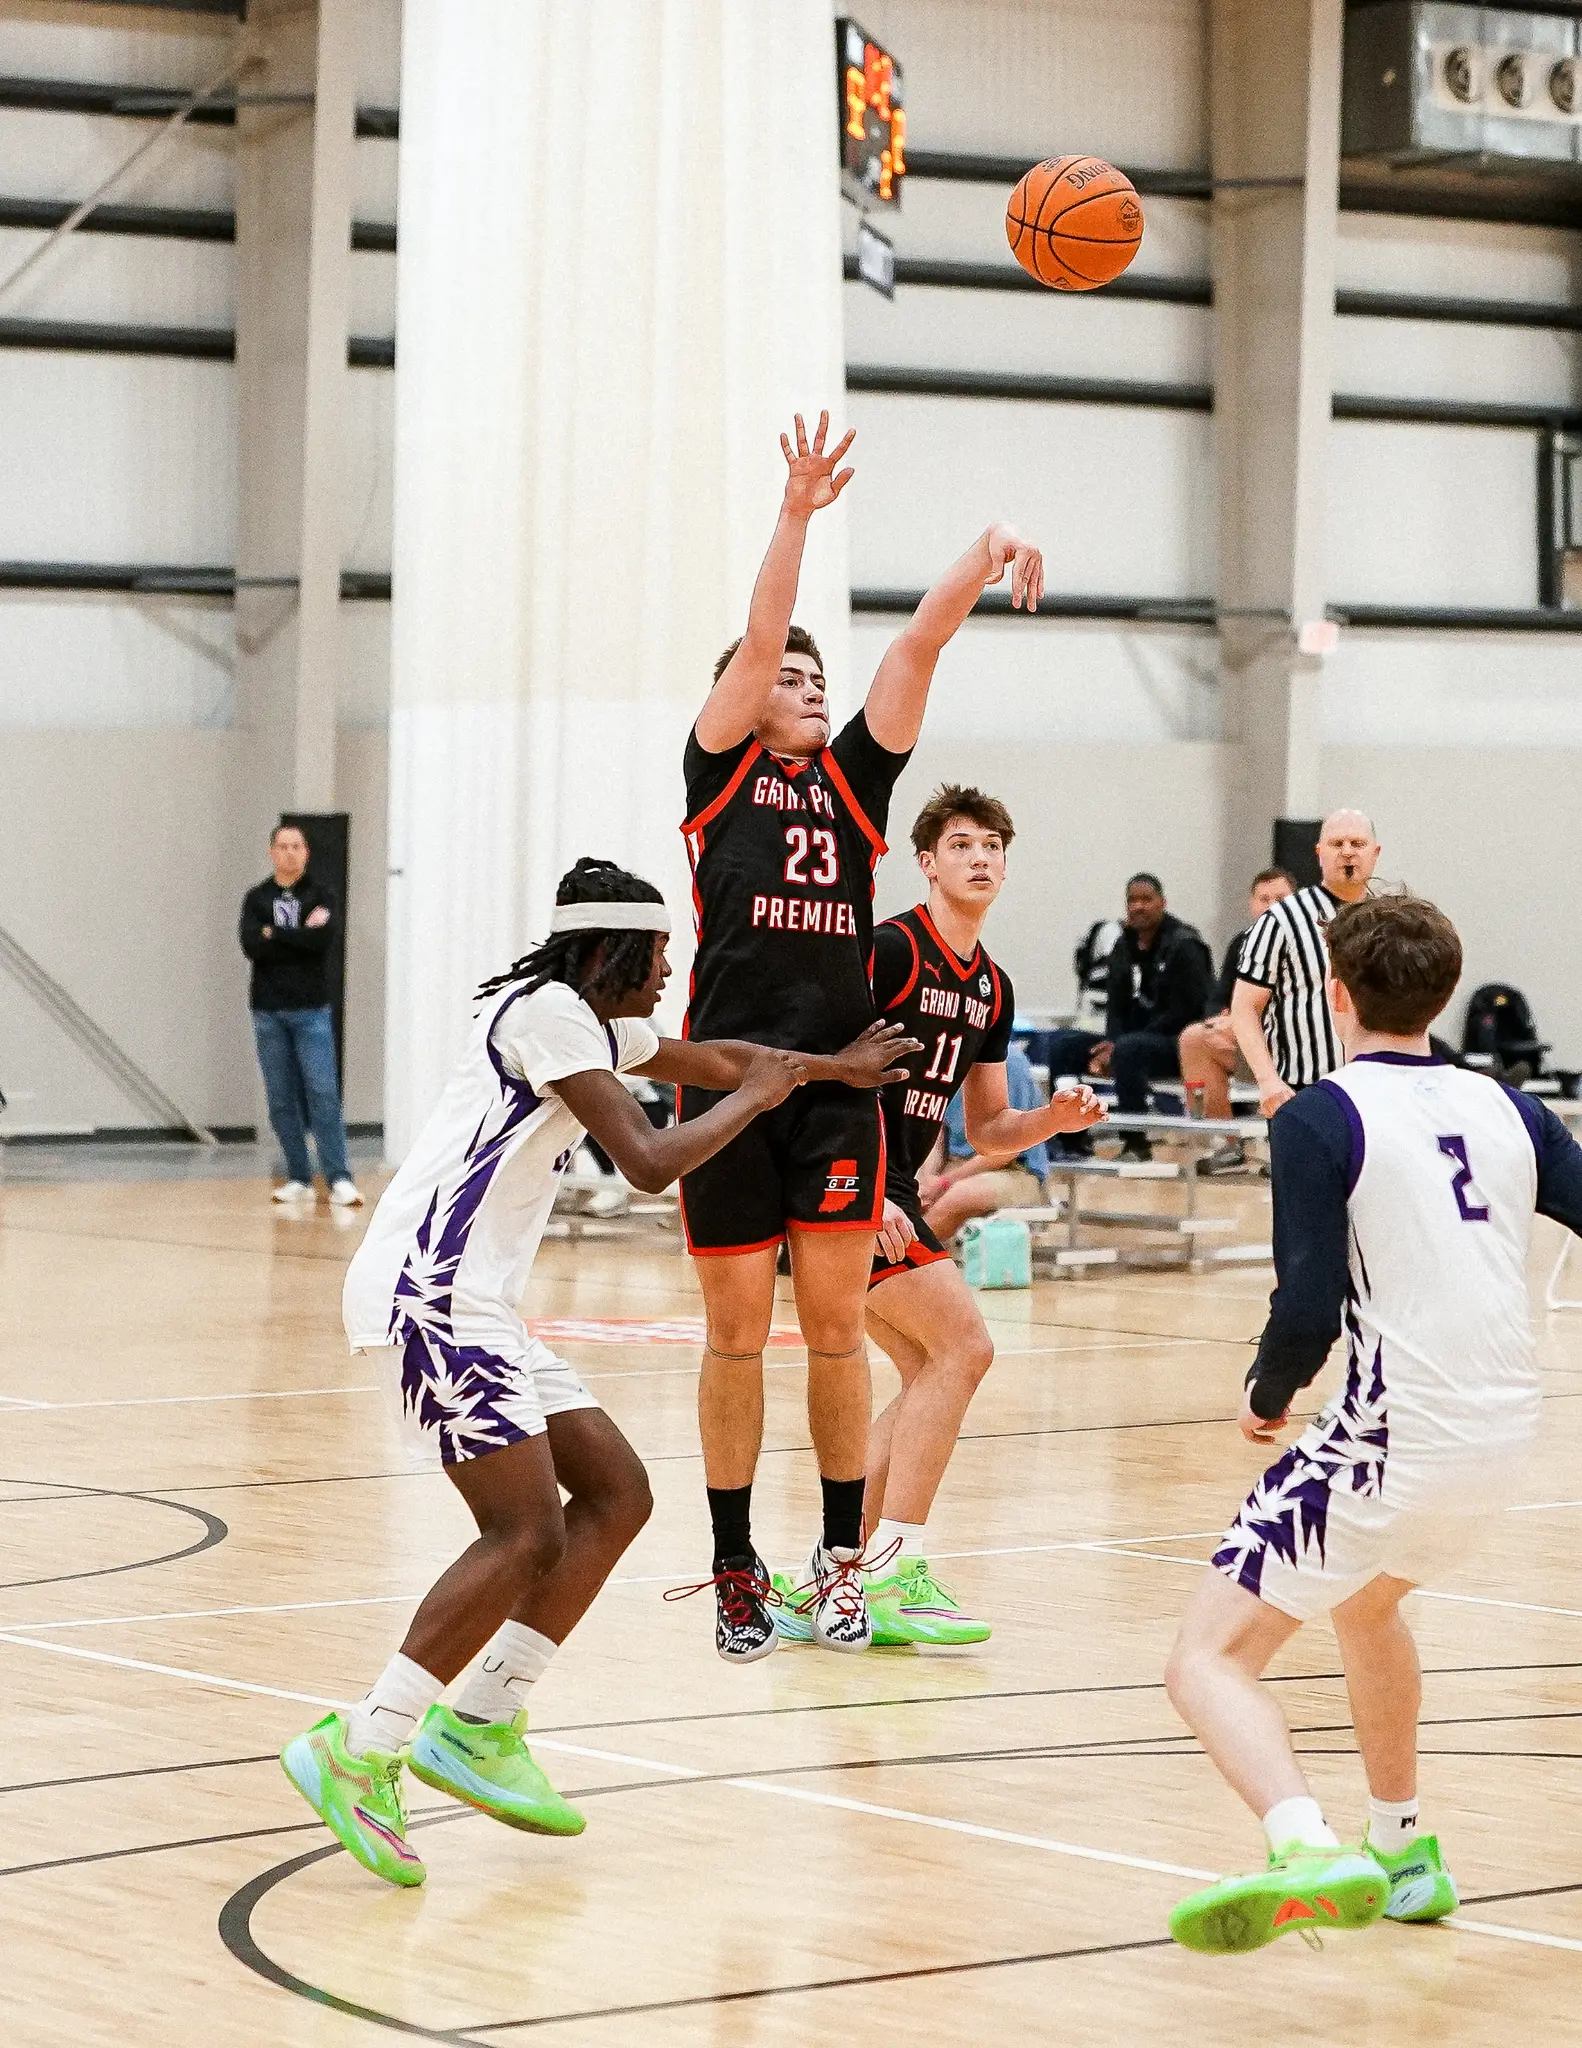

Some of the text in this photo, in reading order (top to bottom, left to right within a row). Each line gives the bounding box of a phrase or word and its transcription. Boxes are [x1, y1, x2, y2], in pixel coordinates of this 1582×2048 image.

[784, 825, 840, 887] 23
[919, 987, 961, 1020] GRAND
[923, 1030, 964, 1084] 11
[1436, 1134, 1490, 1221] 2
